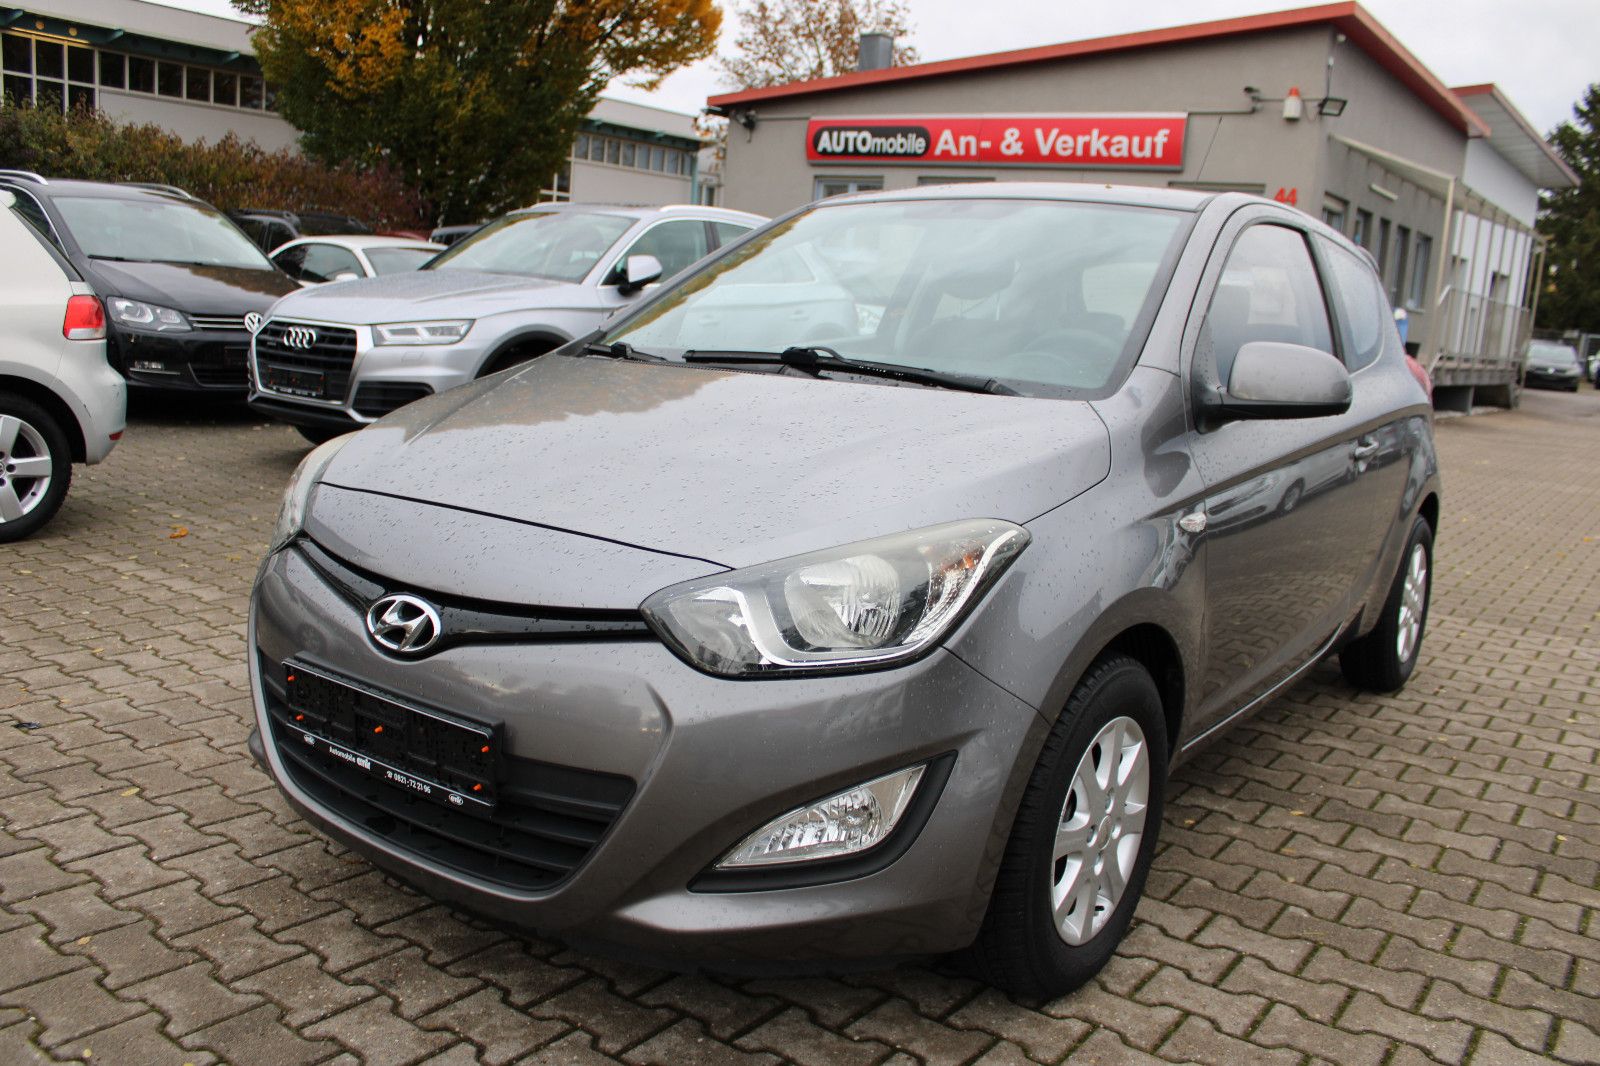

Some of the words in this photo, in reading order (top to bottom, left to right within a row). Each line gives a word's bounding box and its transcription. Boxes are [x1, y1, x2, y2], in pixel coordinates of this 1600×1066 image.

[816, 129, 927, 155] AUTOmobile
[933, 128, 993, 157] An-
[999, 127, 1025, 157] &
[1034, 127, 1171, 159] Verkauf
[1273, 187, 1298, 208] 44
